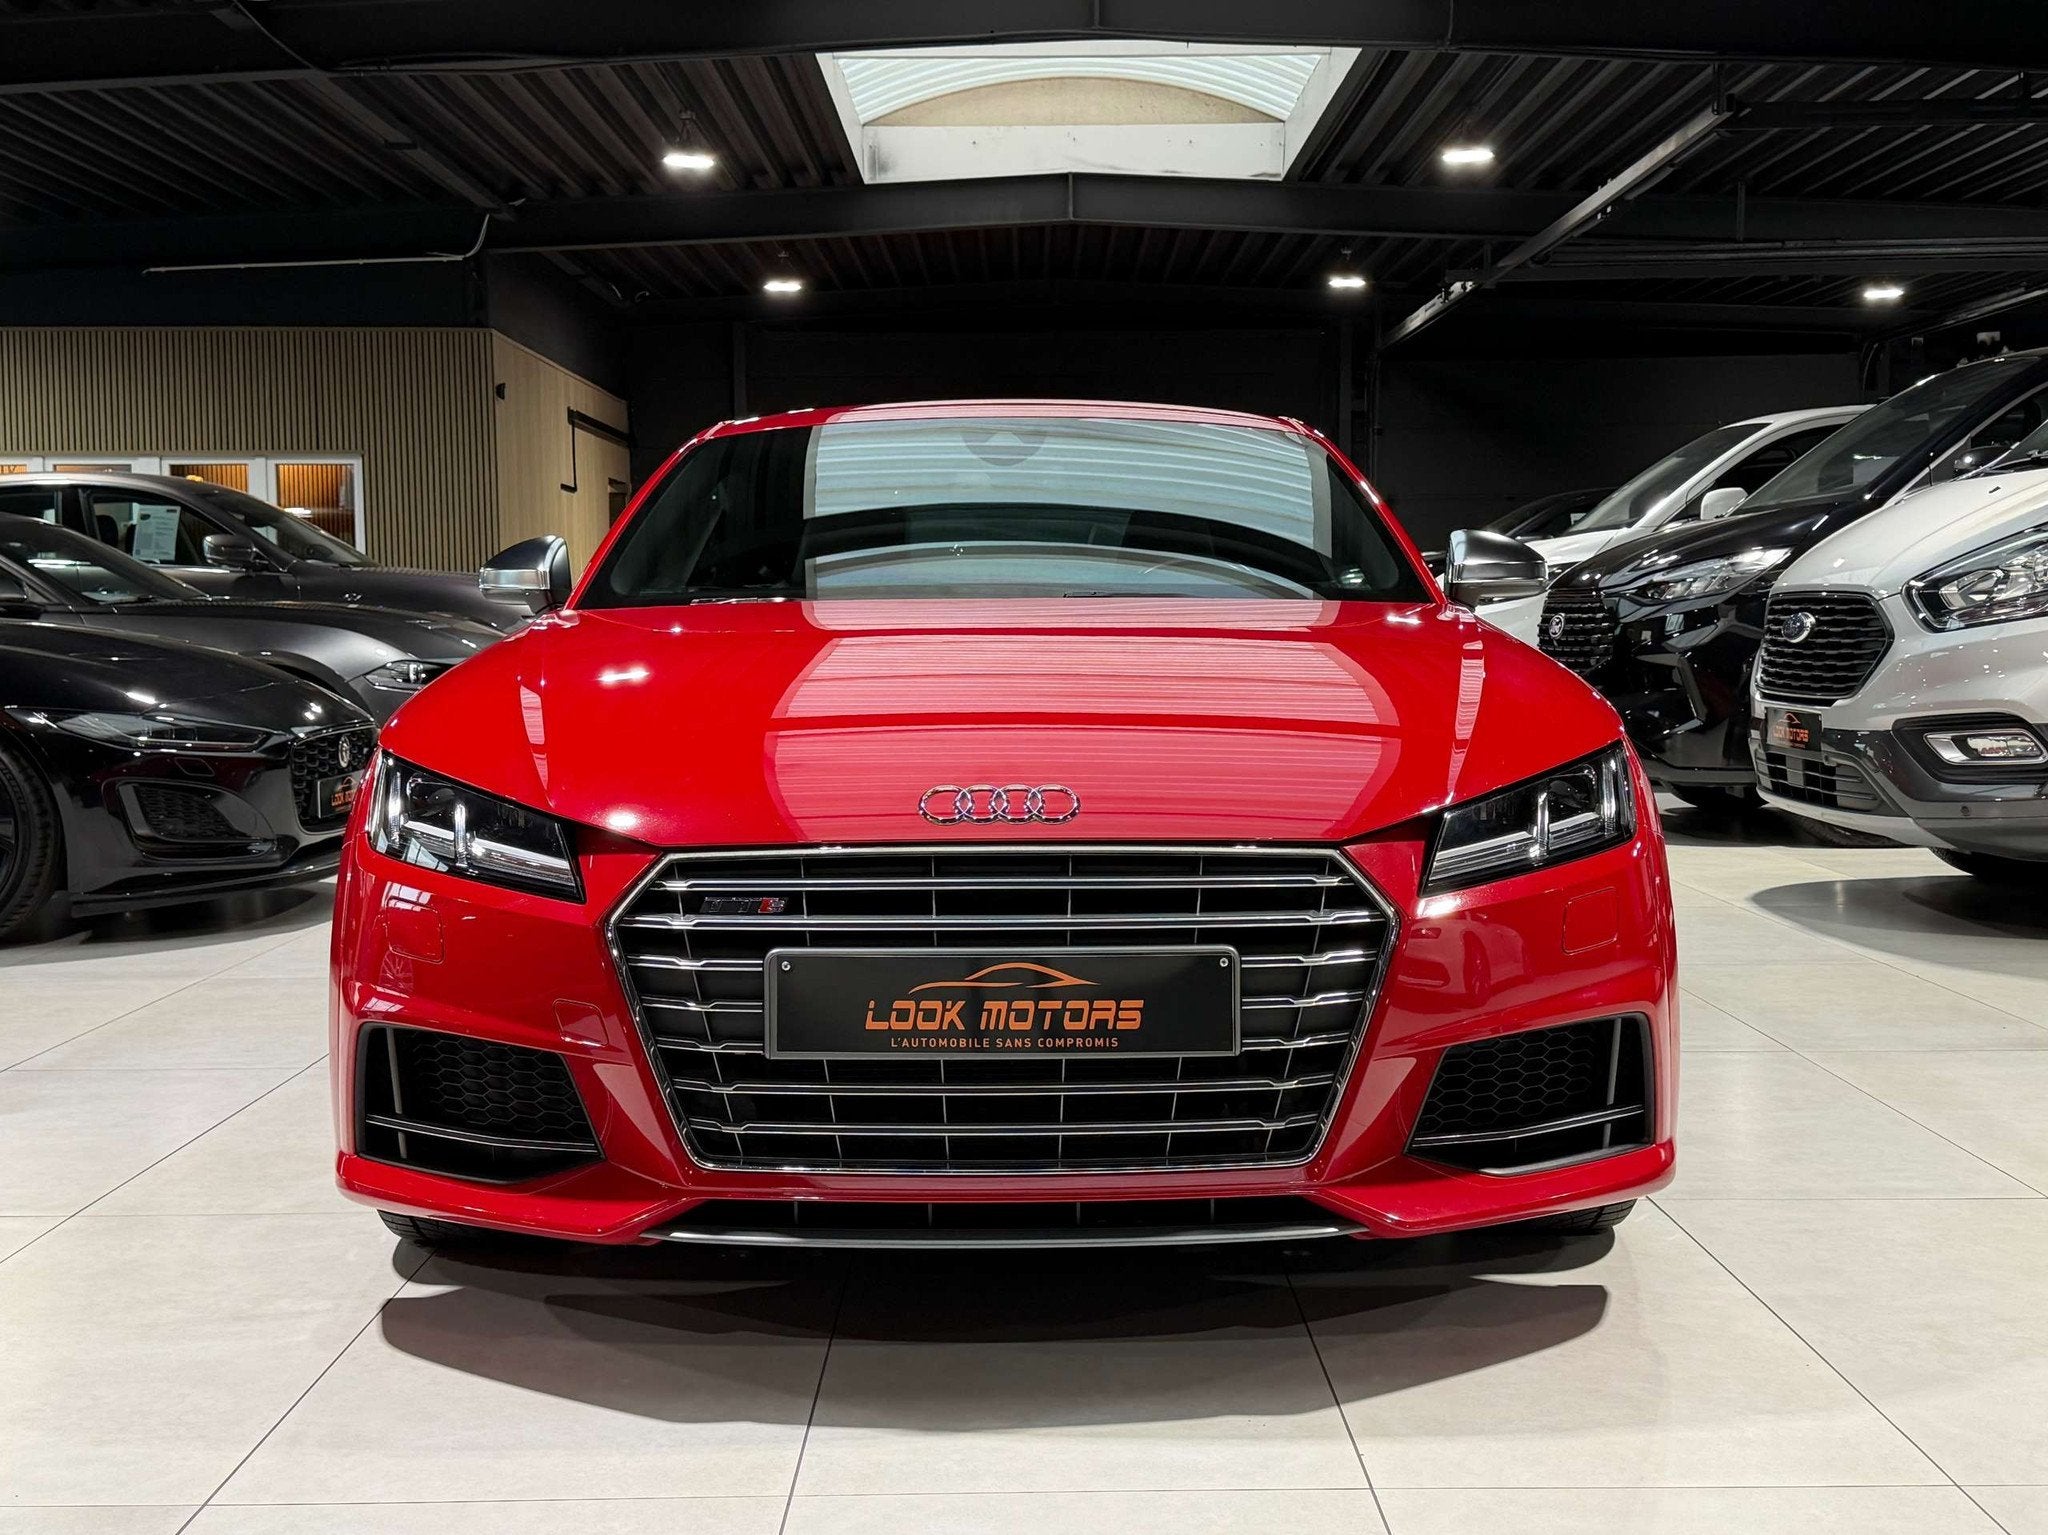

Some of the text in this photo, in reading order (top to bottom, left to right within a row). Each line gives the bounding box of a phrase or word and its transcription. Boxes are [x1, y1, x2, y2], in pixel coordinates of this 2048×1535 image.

[865, 999, 1145, 1031] LOOK MOTORS
[891, 1037, 1119, 1048] L'AUTOMOBILE SANS COMPROMIS
